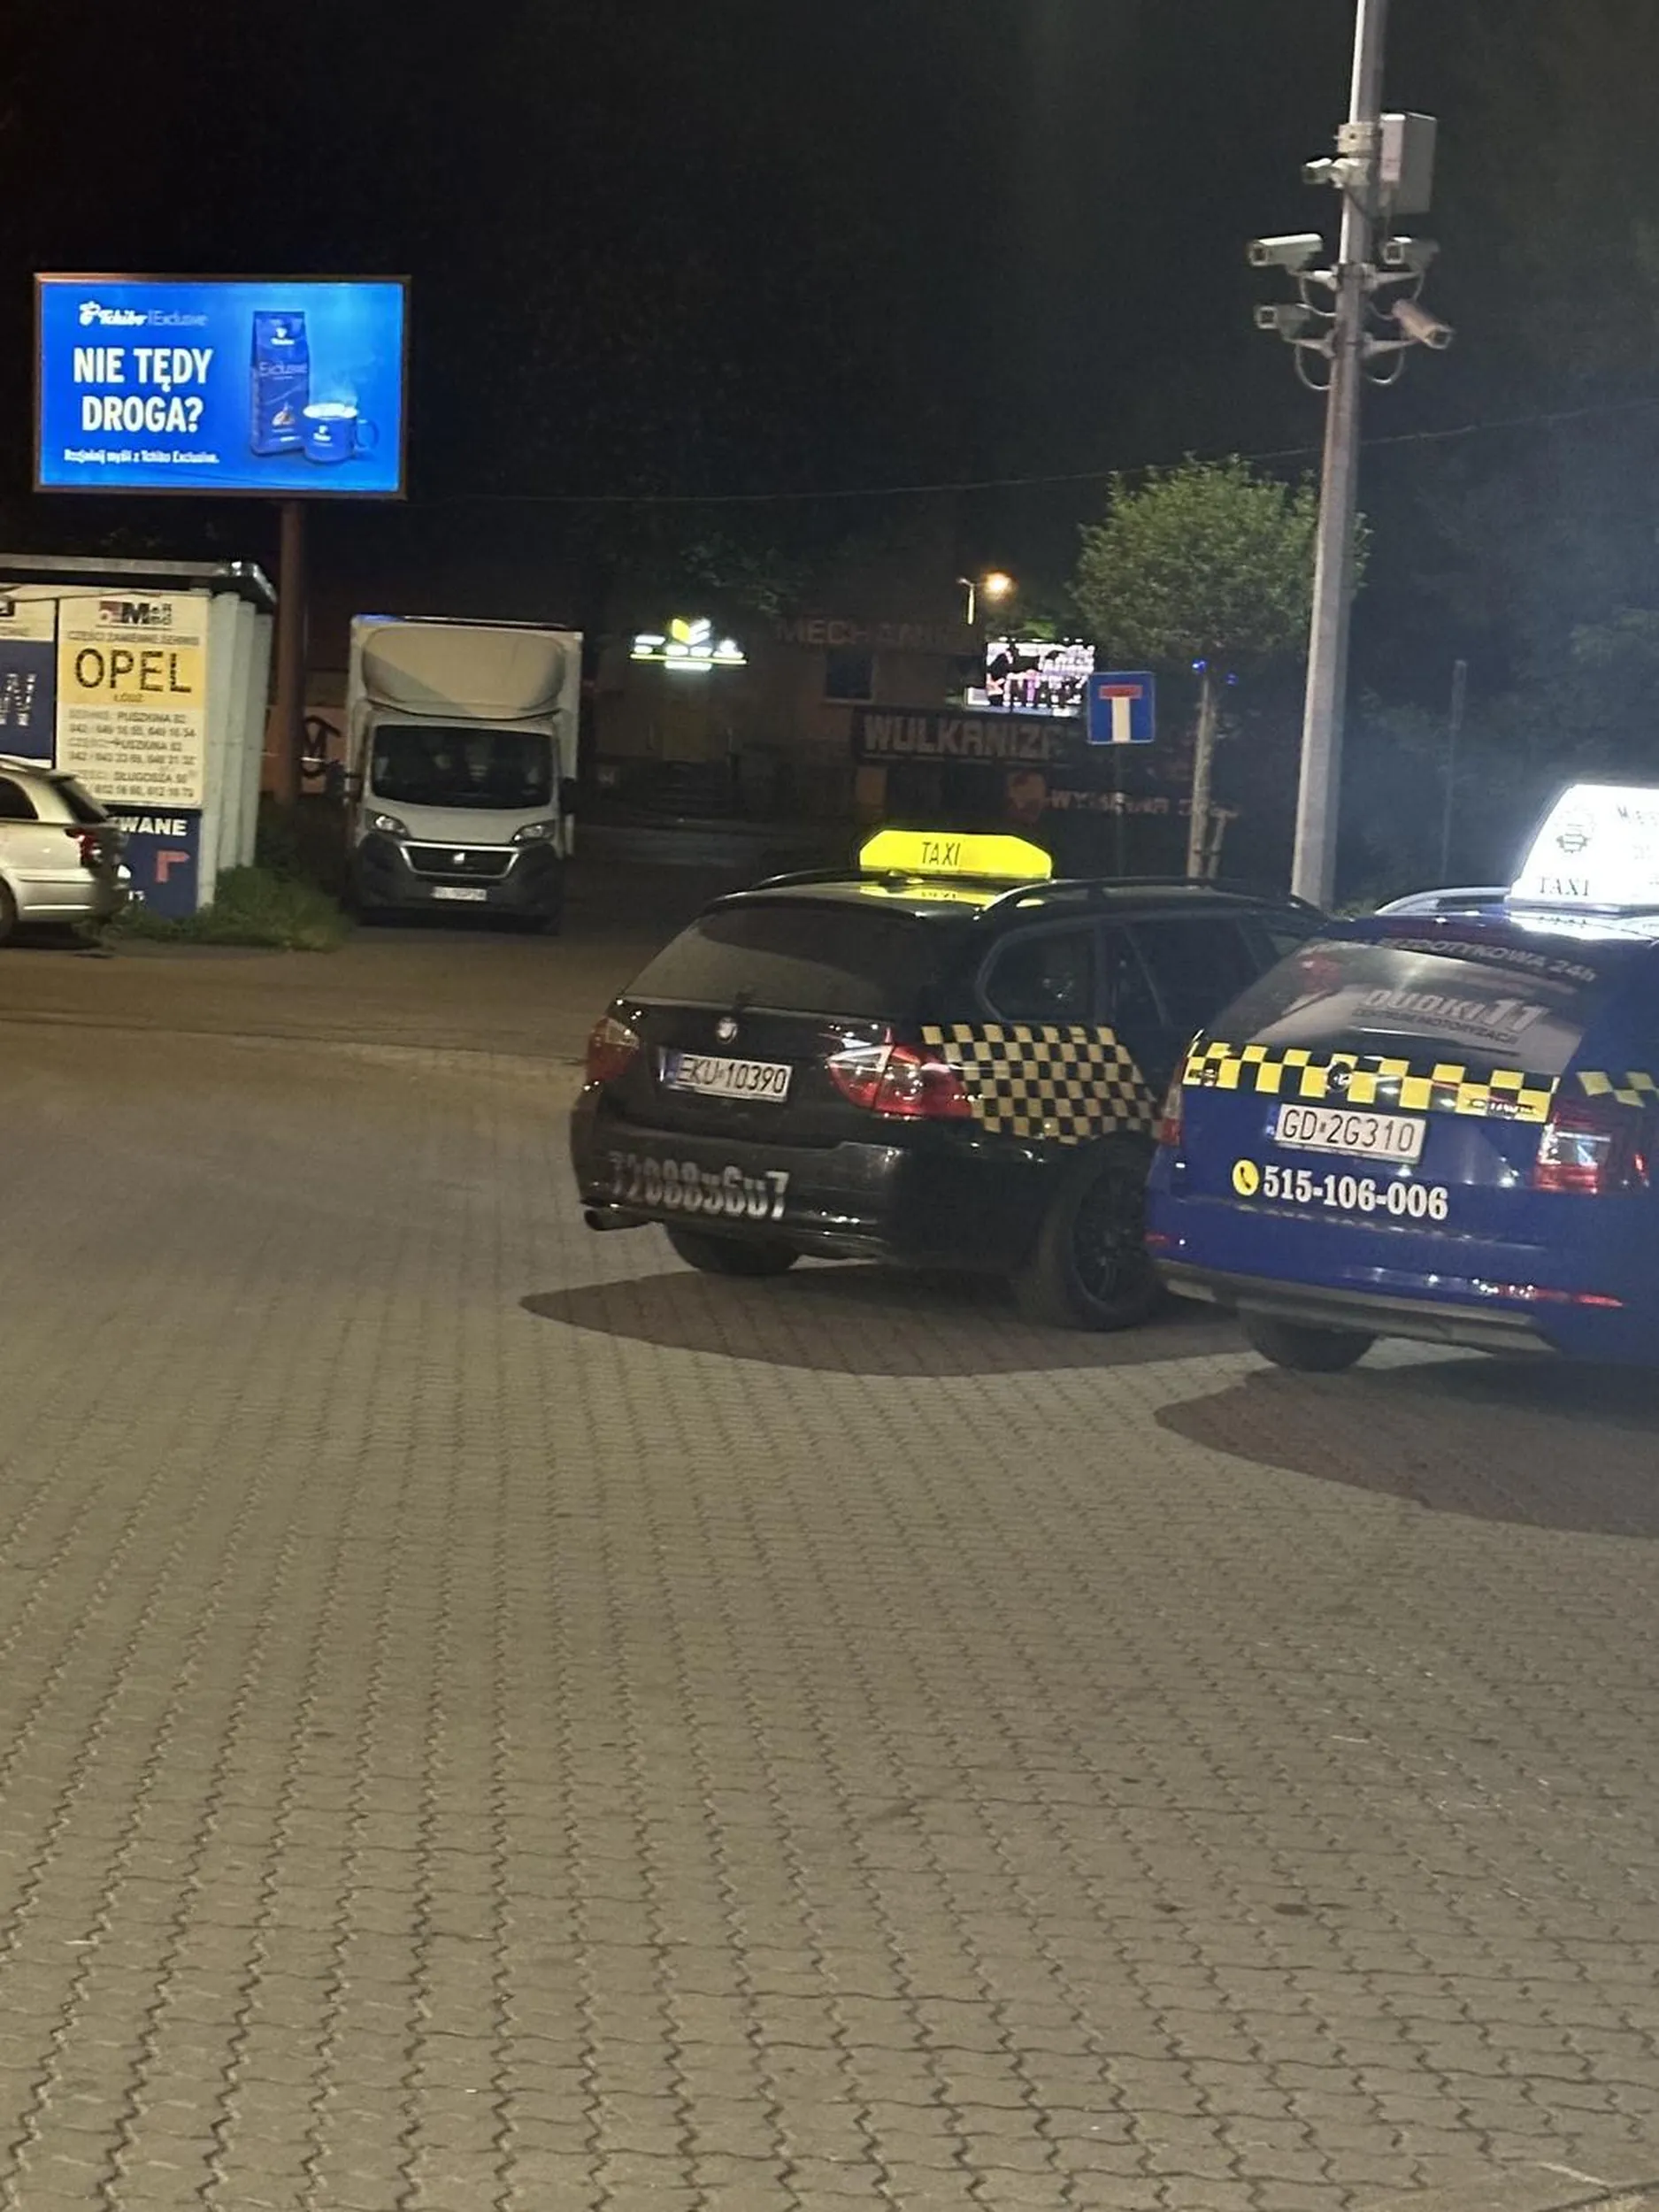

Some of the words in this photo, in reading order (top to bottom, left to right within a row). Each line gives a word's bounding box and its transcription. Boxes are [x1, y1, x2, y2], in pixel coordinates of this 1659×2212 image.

[73, 348, 124, 383] NIE
[134, 349, 213, 392] TĘDY
[82, 396, 204, 432] DROGA?
[75, 648, 192, 693] OPEL
[110, 816, 188, 836] WANE
[922, 841, 961, 867] TAXI
[1537, 875, 1589, 897] TAXI
[677, 1056, 719, 1085] EKU
[726, 1062, 787, 1094] 10390
[1282, 1109, 1317, 1141] GD
[1326, 1114, 1416, 1153] 2G310
[1263, 1164, 1448, 1221] 515-106-006
